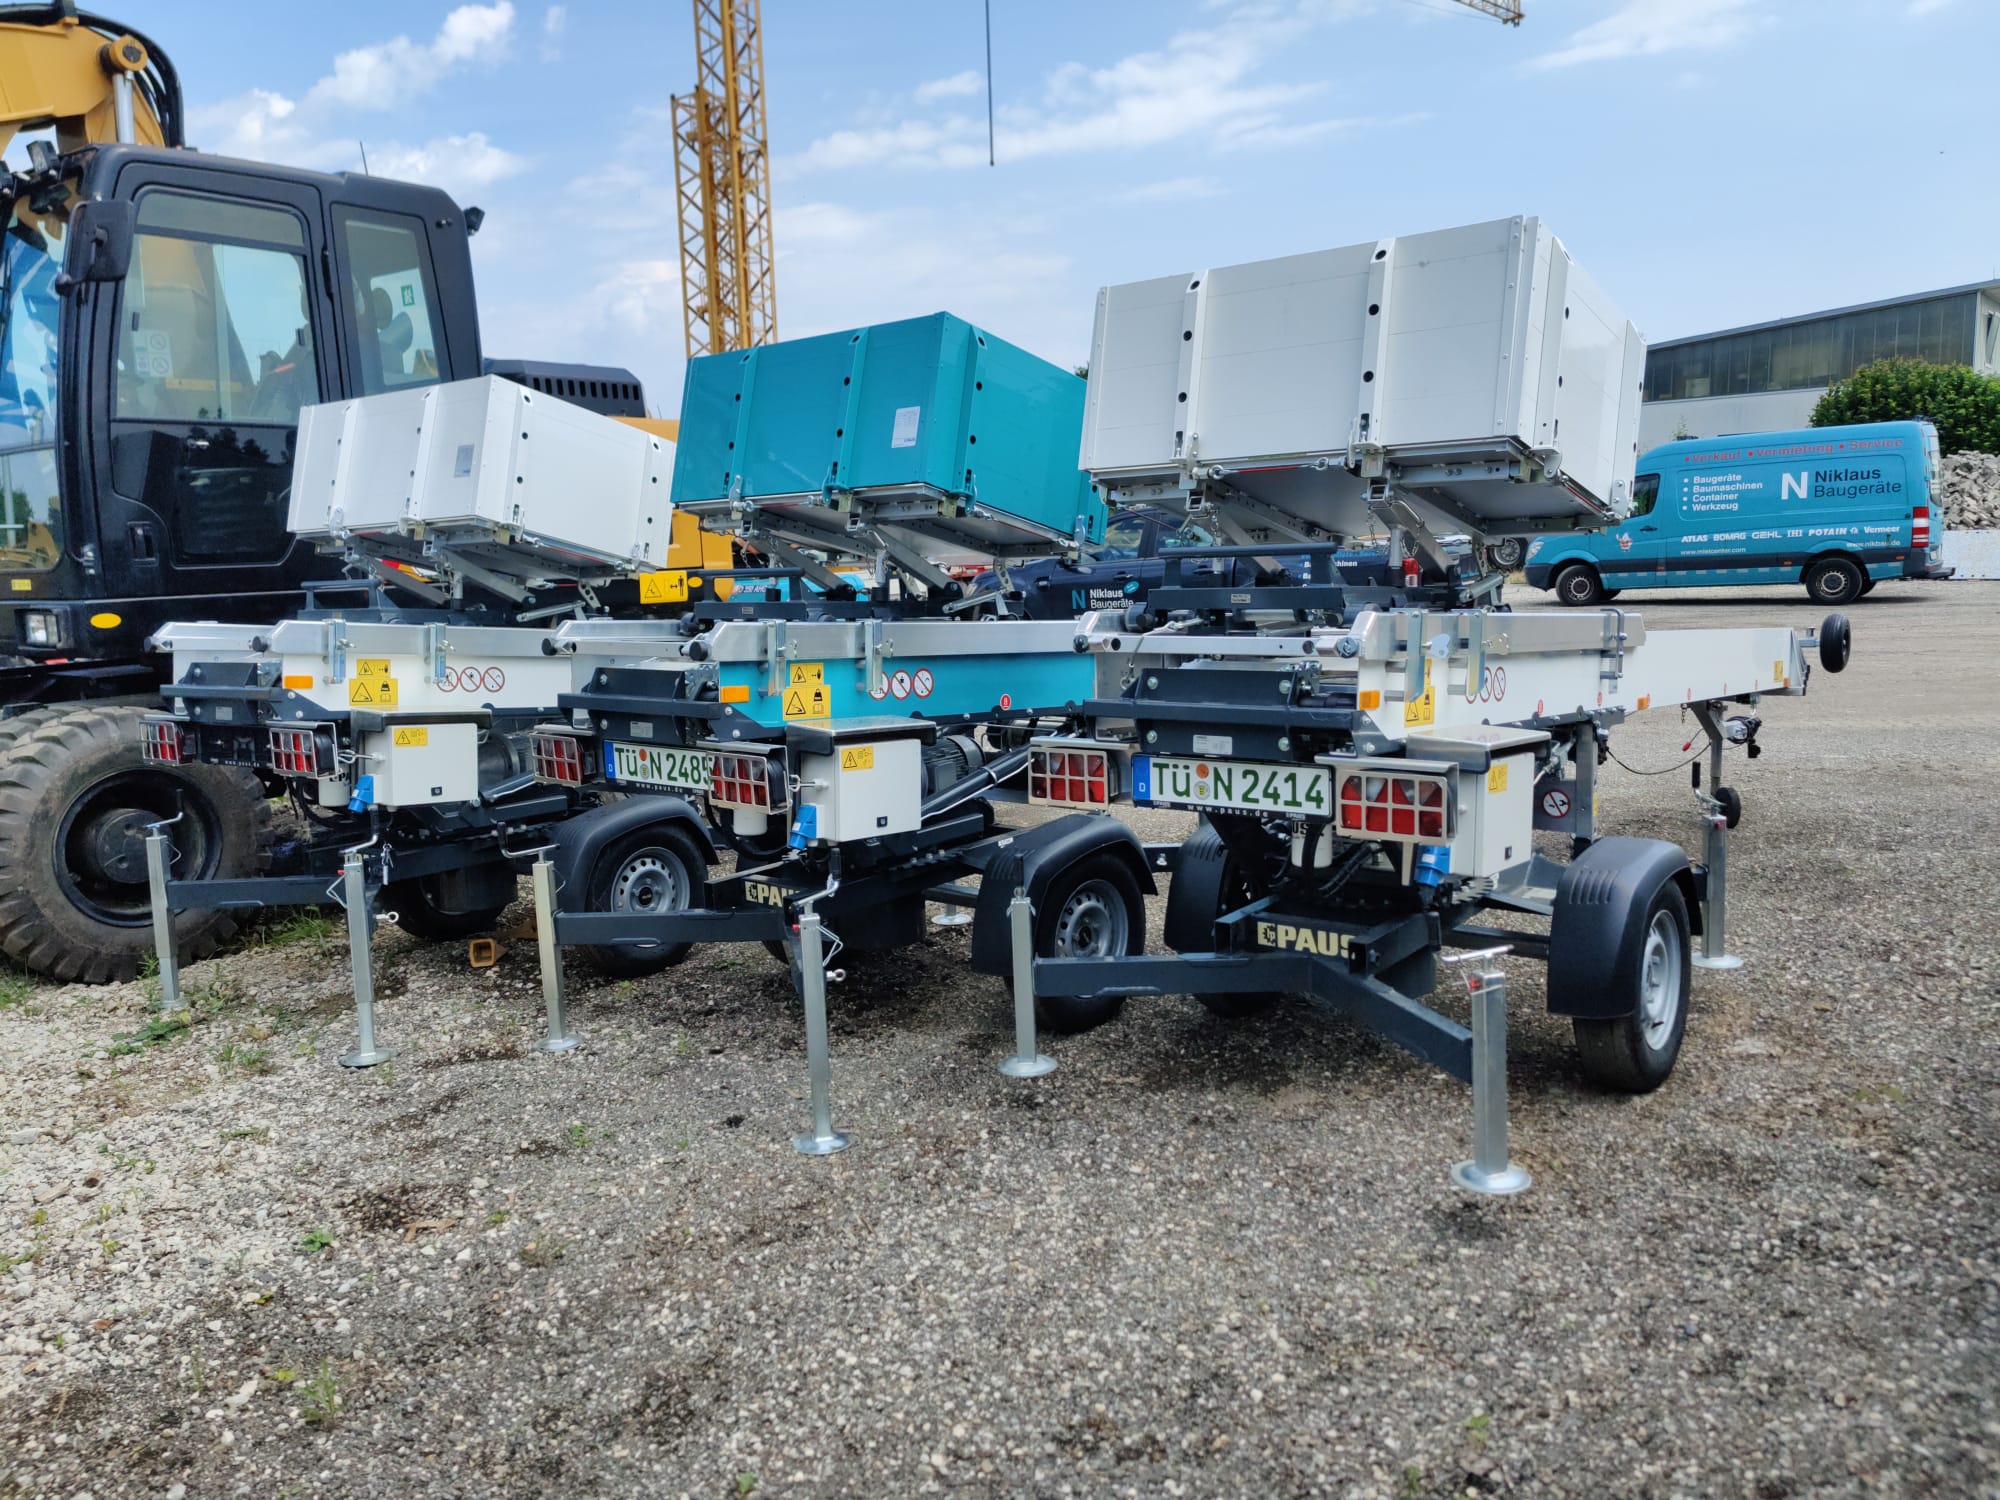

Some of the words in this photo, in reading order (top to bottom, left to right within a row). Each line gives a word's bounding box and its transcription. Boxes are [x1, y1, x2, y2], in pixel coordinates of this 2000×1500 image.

[1692, 451, 1741, 463] Verkauf
[1757, 443, 1834, 457] Vermietung
[1850, 438, 1903, 450] Service
[1693, 473, 1742, 484] Baugeräte
[1814, 468, 1881, 483] Niklaus
[1693, 481, 1763, 493] Baumaschinen
[1781, 471, 1809, 500] N
[1814, 480, 1902, 498] Baugeräte
[1692, 492, 1738, 502] Container
[1692, 502, 1738, 512] Werkzeug
[1681, 534, 1708, 543] ATLAS
[1752, 529, 1783, 539] GEHL
[1808, 527, 1848, 537] POTAIN
[1864, 525, 1900, 534] Vermeer
[1072, 589, 1086, 609] N
[1089, 588, 1124, 599] Niklaus
[1090, 598, 1135, 610] Baugeräte
[1138, 782, 1146, 792] D
[1152, 762, 1190, 798] TÜ
[1242, 769, 1325, 809] 2414
[1186, 804, 1269, 818] www.paus.de
